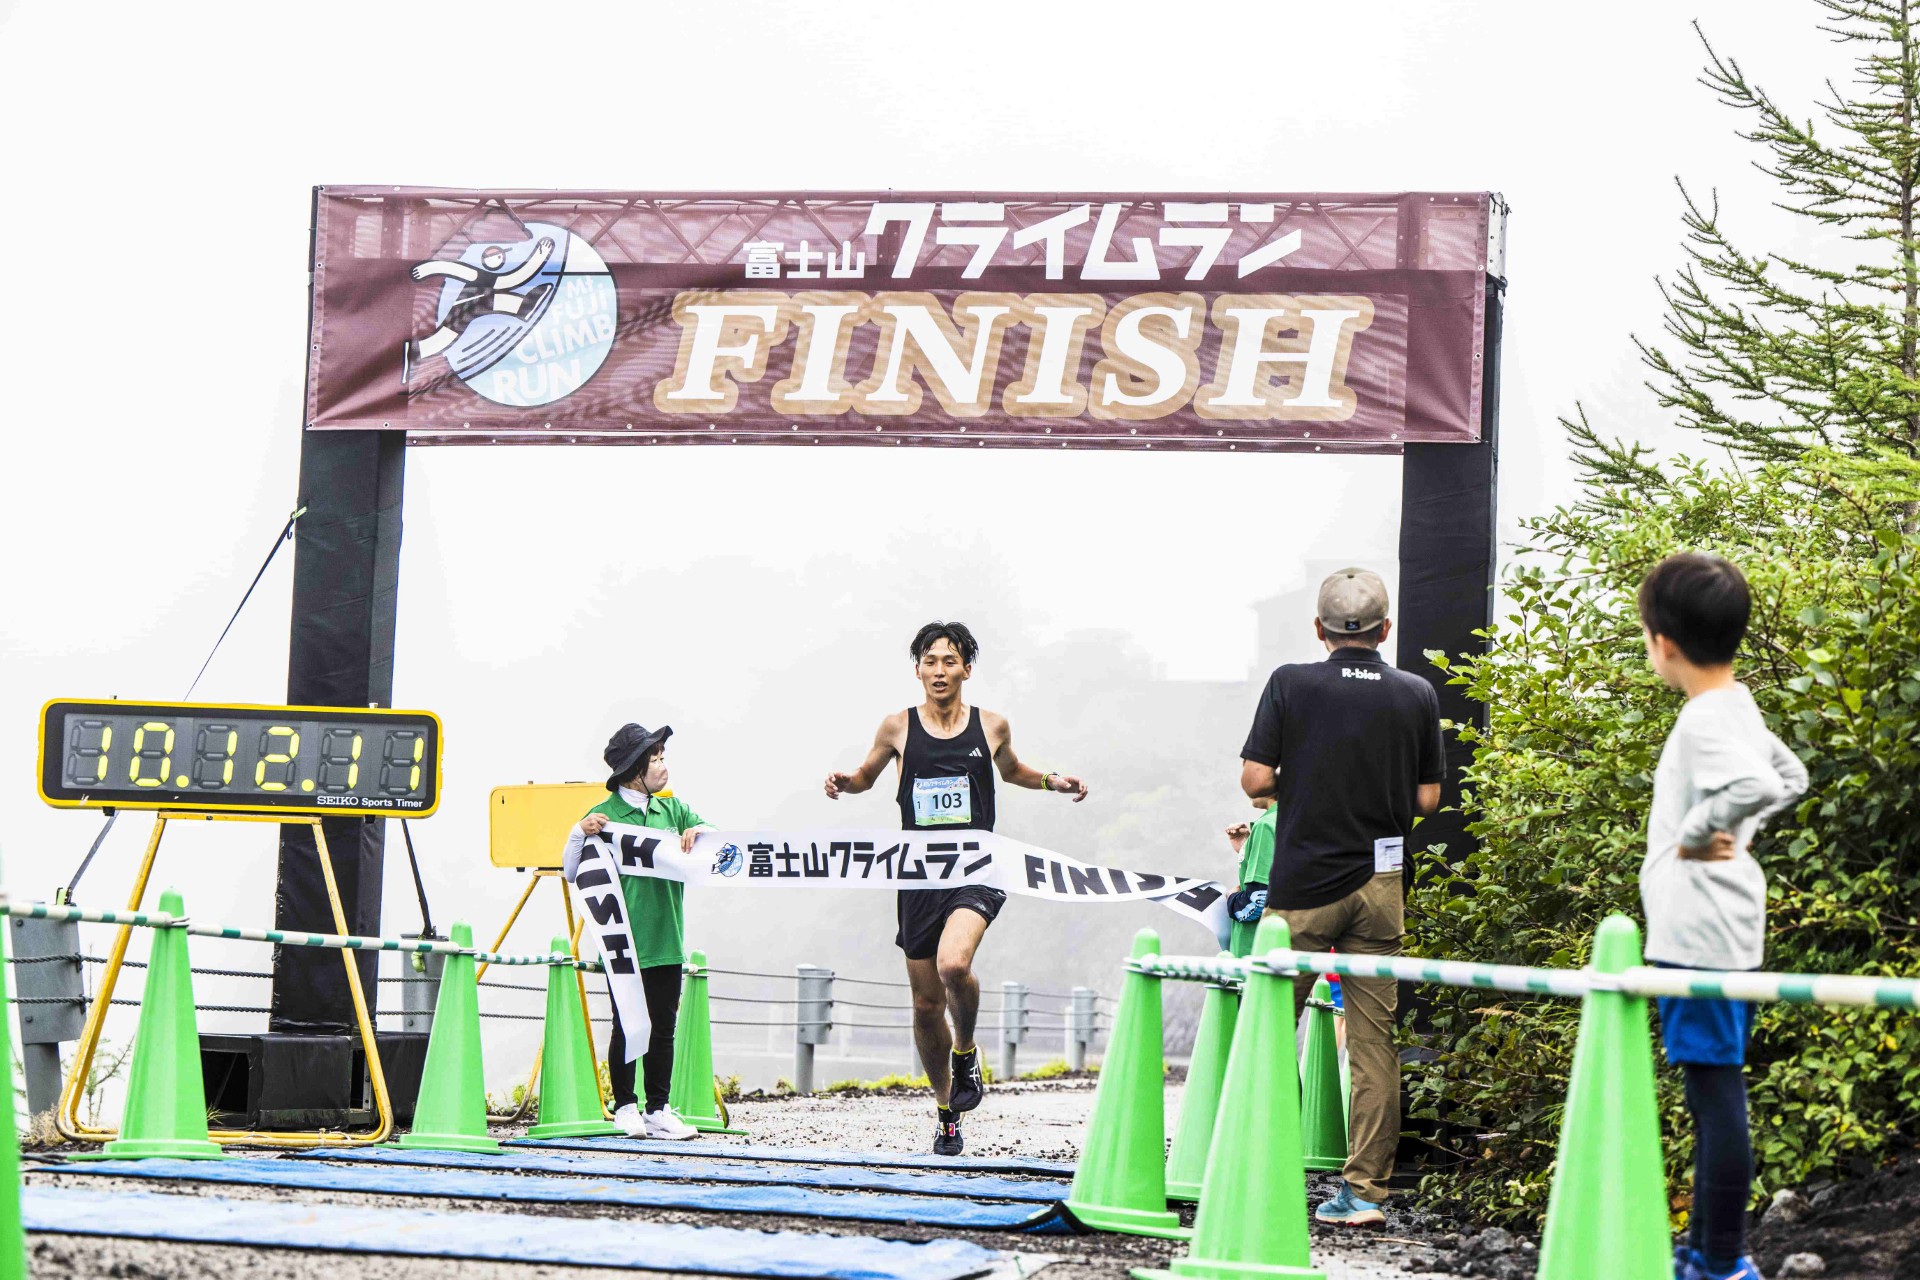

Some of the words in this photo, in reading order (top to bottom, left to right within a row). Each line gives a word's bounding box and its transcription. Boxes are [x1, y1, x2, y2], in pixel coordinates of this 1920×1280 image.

[742, 202, 1301, 280] 富士山クライムラン
[551, 284, 608, 325] FUJI
[515, 314, 612, 364] CLIMB
[667, 303, 1361, 408] FINISH
[492, 358, 581, 406] RUN
[317, 796, 359, 805] SEIKO
[361, 798, 393, 807] Sports
[395, 798, 423, 807] Timer
[932, 793, 962, 809] 103
[747, 842, 992, 879] 富士山クライムラン
